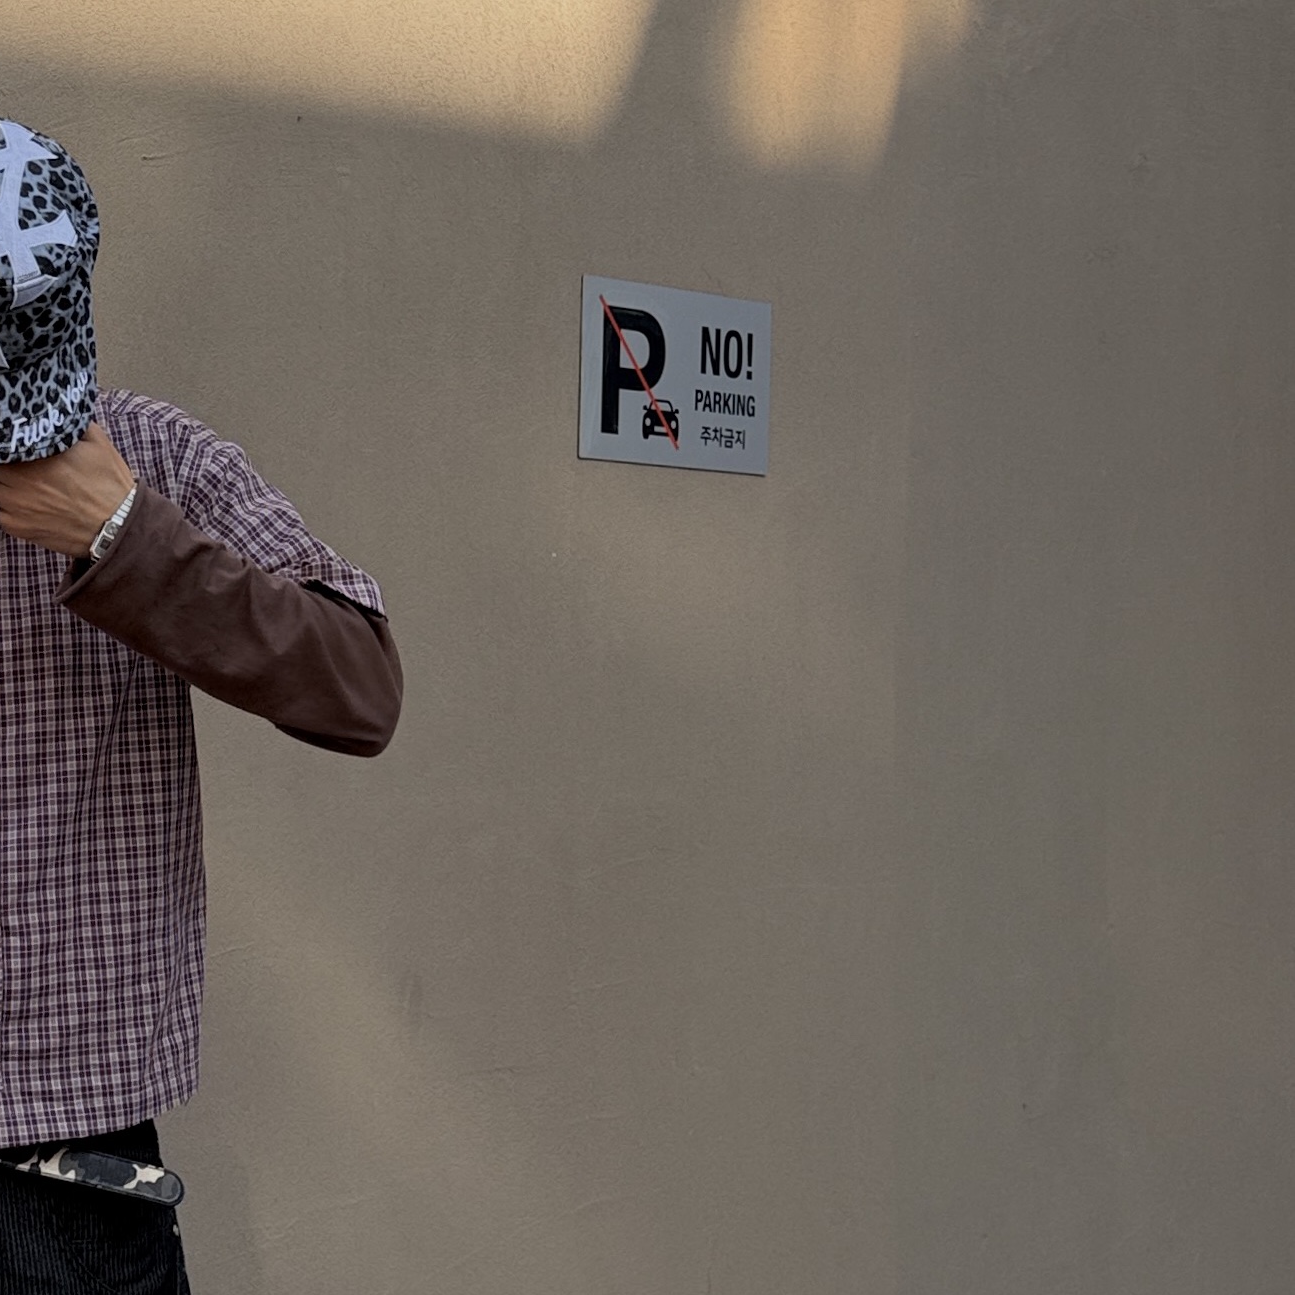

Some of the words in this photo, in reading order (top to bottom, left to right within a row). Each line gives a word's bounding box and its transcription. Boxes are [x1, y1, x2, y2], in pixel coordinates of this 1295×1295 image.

[700, 326, 754, 380] NO!
[10, 402, 65, 454] Fuck
[60, 371, 88, 414] You
[694, 389, 756, 418] PARKING
[700, 426, 746, 450] 주차금지
